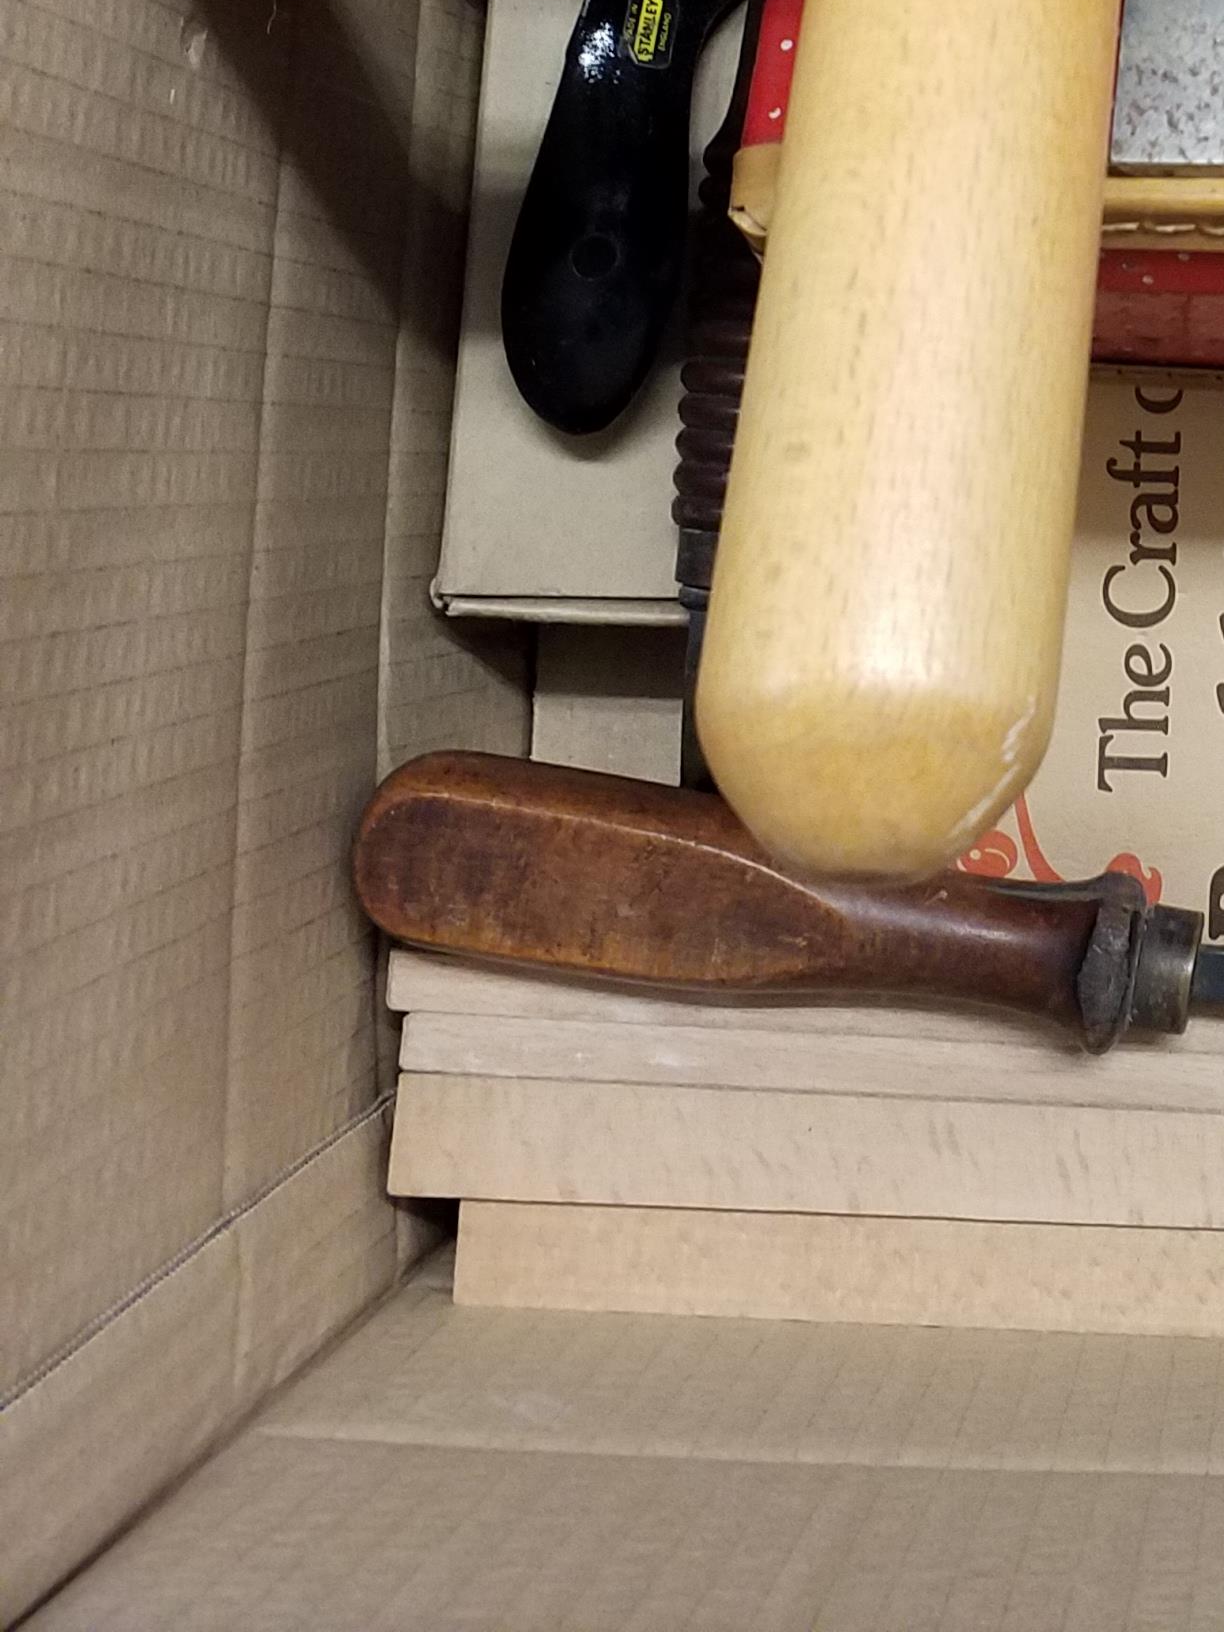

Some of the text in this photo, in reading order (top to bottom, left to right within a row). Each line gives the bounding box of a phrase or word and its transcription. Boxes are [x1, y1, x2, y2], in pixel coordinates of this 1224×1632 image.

[658, 13, 672, 51] ENGLAND
[1101, 429, 1182, 629] Craft
[1096, 641, 1173, 793] The
